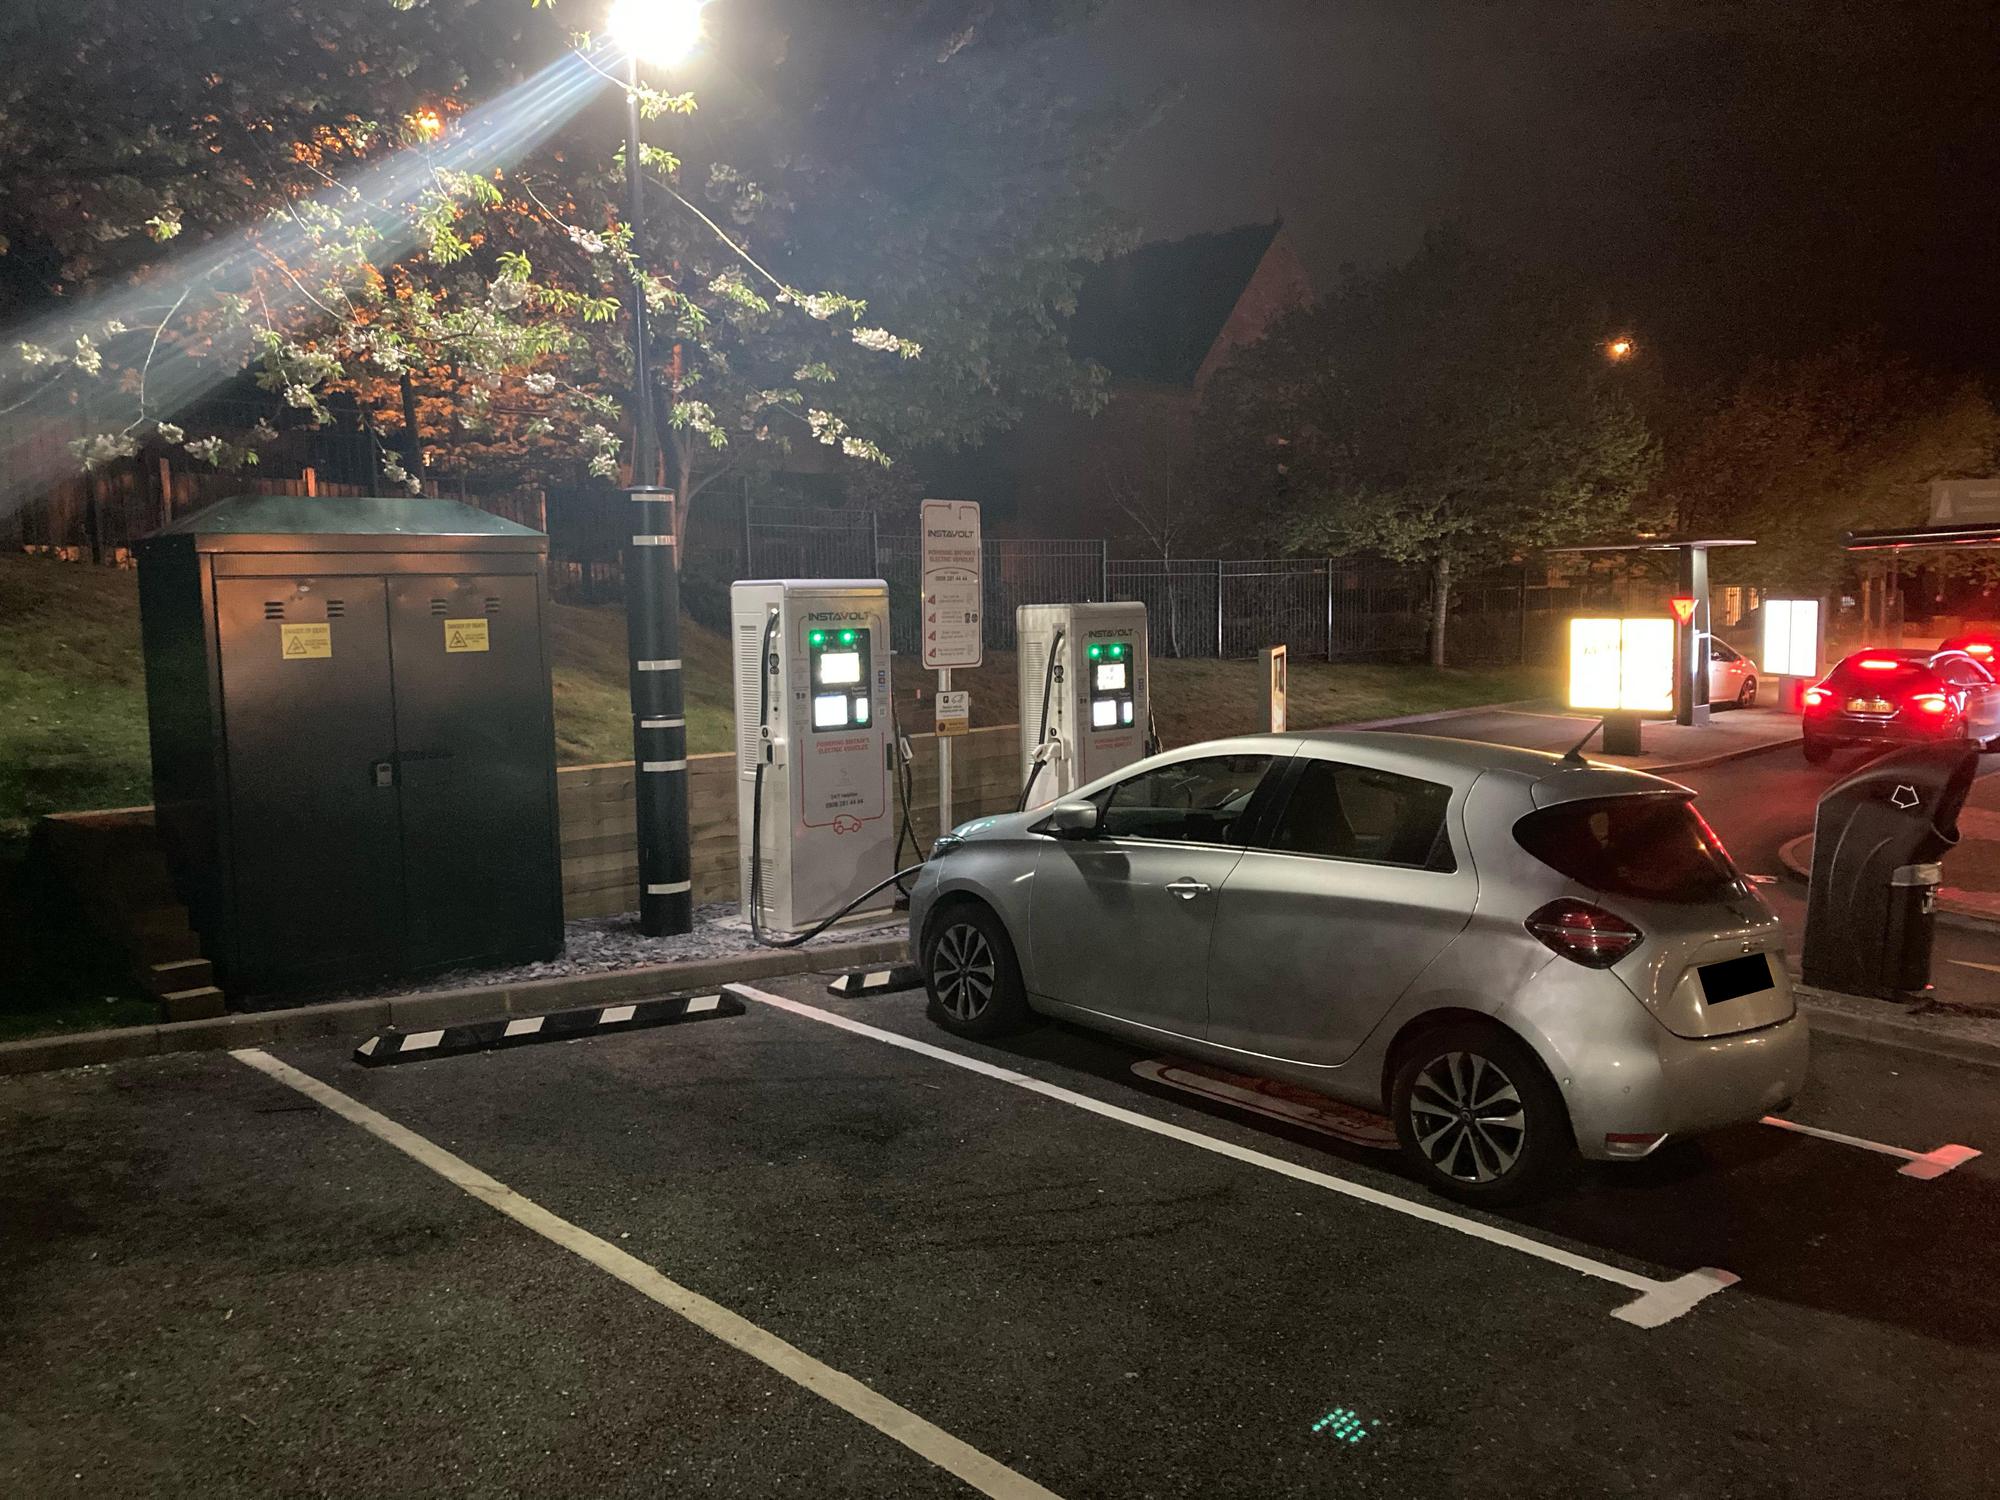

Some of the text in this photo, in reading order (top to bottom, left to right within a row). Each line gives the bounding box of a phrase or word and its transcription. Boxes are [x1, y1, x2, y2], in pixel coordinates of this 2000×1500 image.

[927, 529, 975, 538] INSTAVOLT
[808, 611, 869, 622] INSTAVOLT
[1088, 628, 1134, 638] INSTAVOLT
